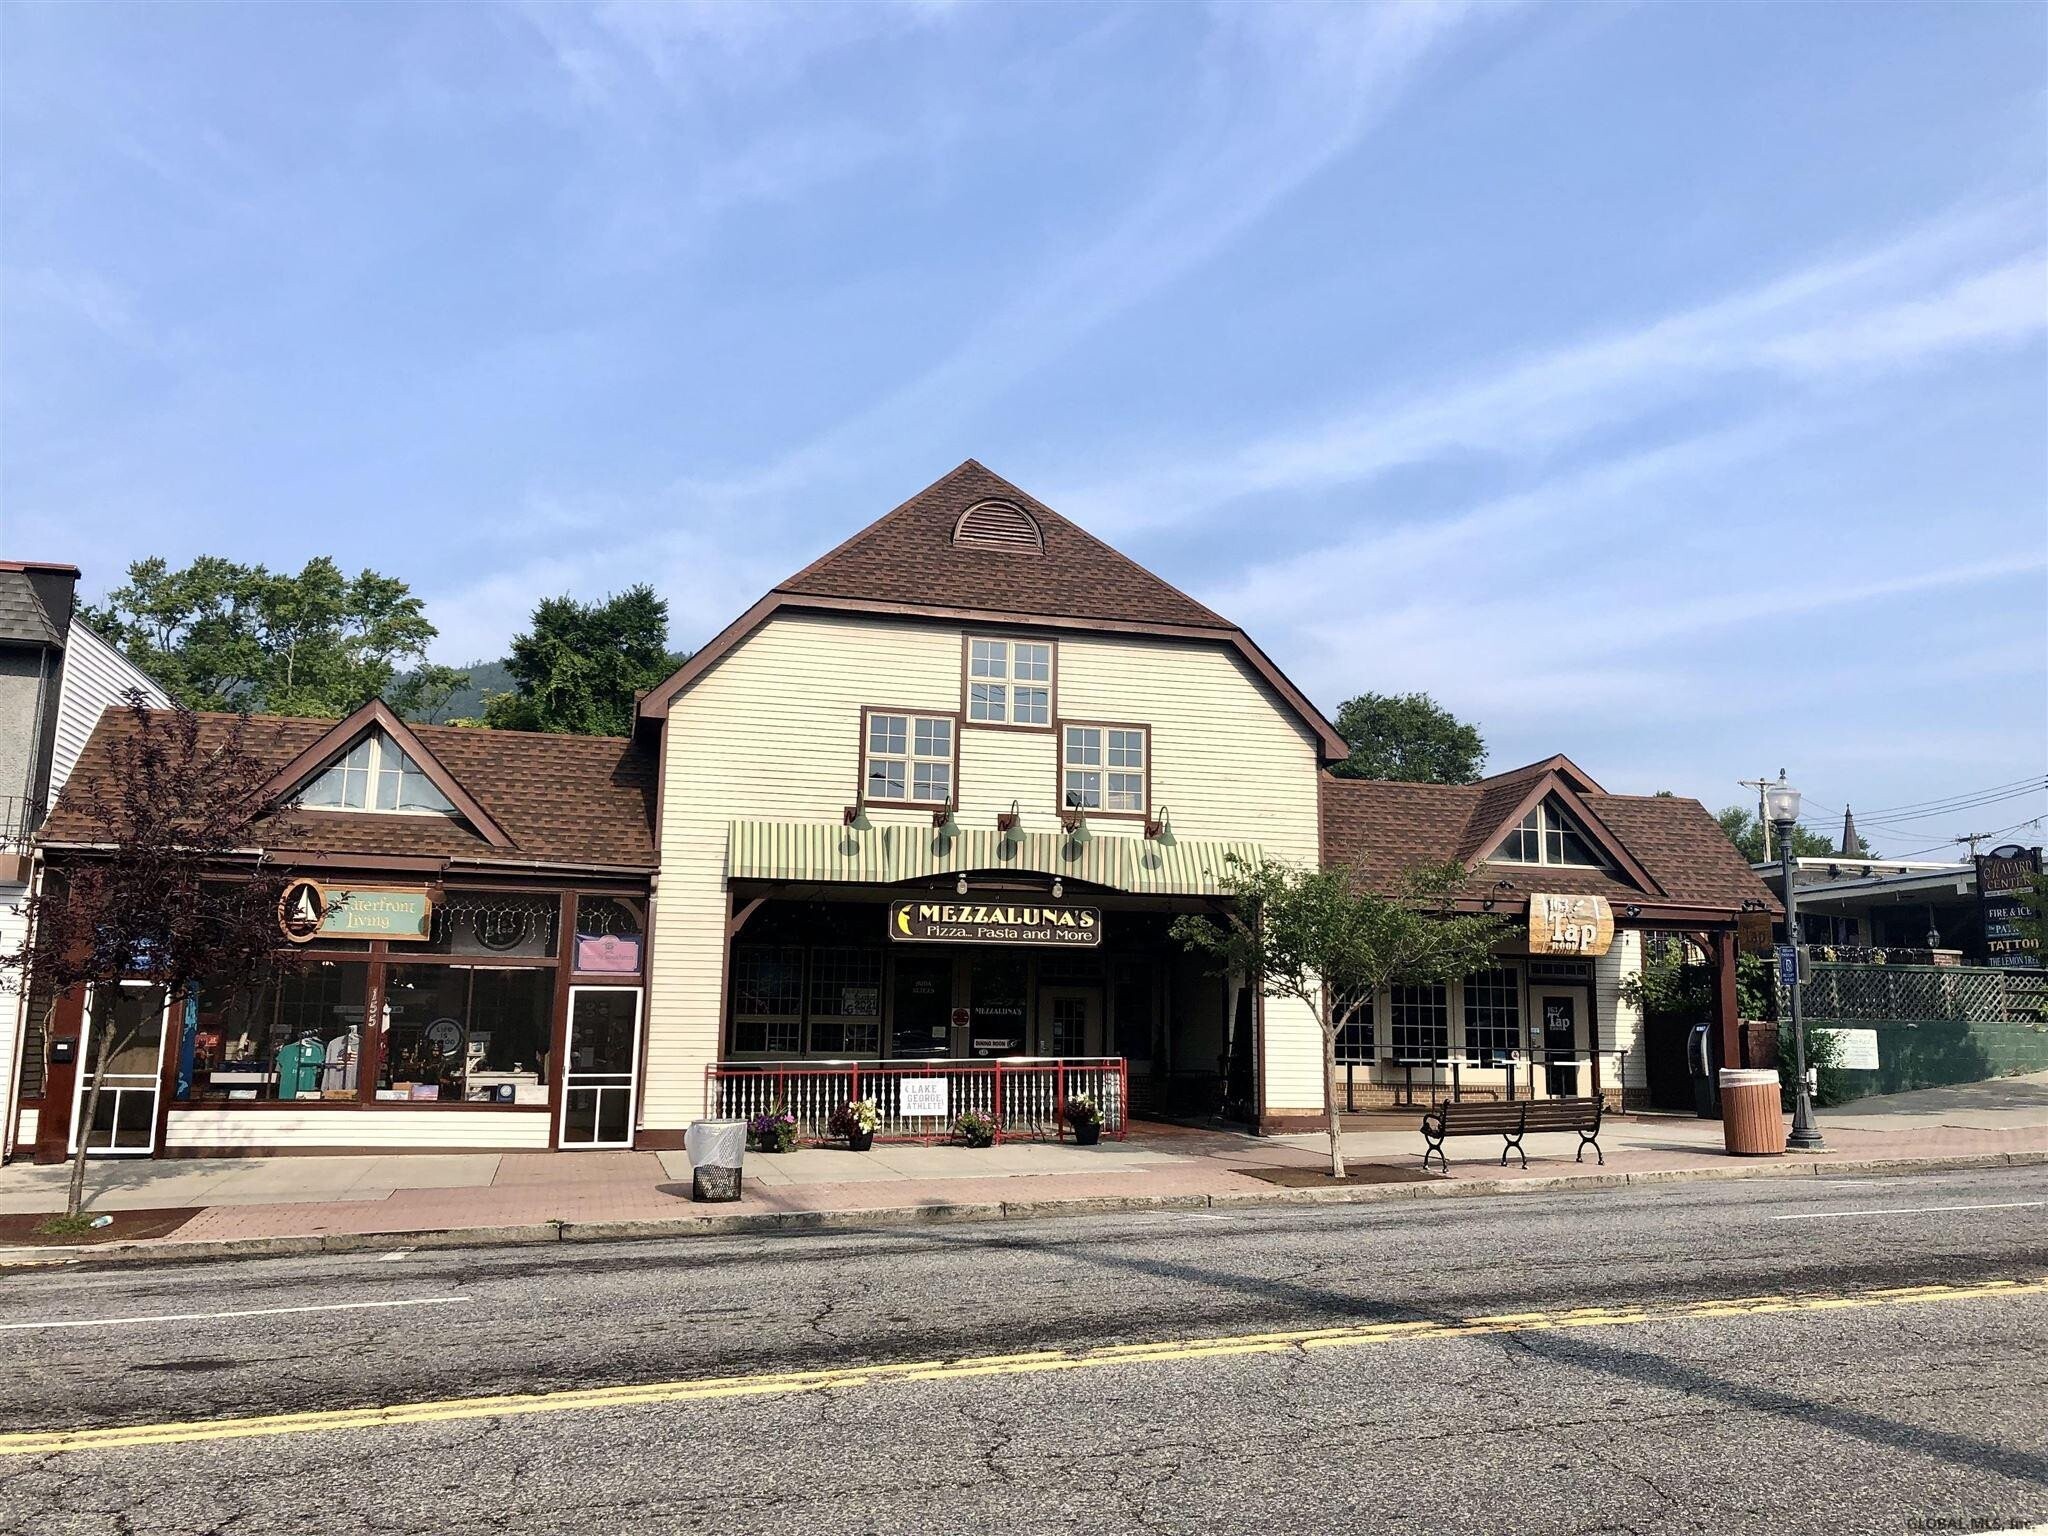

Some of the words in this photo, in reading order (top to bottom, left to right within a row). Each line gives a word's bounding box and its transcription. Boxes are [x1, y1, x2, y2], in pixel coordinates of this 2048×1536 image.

[918, 904, 1094, 927] MEZZALUNA'S
[1989, 907, 2008, 919] FIRE
[2009, 907, 2016, 917] &
[2017, 905, 2032, 916] ICE
[347, 912, 391, 928] Living
[977, 927, 1018, 939] Pasta
[1023, 928, 1050, 940] and
[1055, 929, 1092, 941] More
[1548, 911, 1597, 951] Tap
[367, 987, 378, 1027] 155
[1548, 1012, 1570, 1031] Tap
[911, 1085, 937, 1094] LAKE
[907, 1094, 941, 1102] GEORGE
[907, 1102, 942, 1110] ATHLETE
